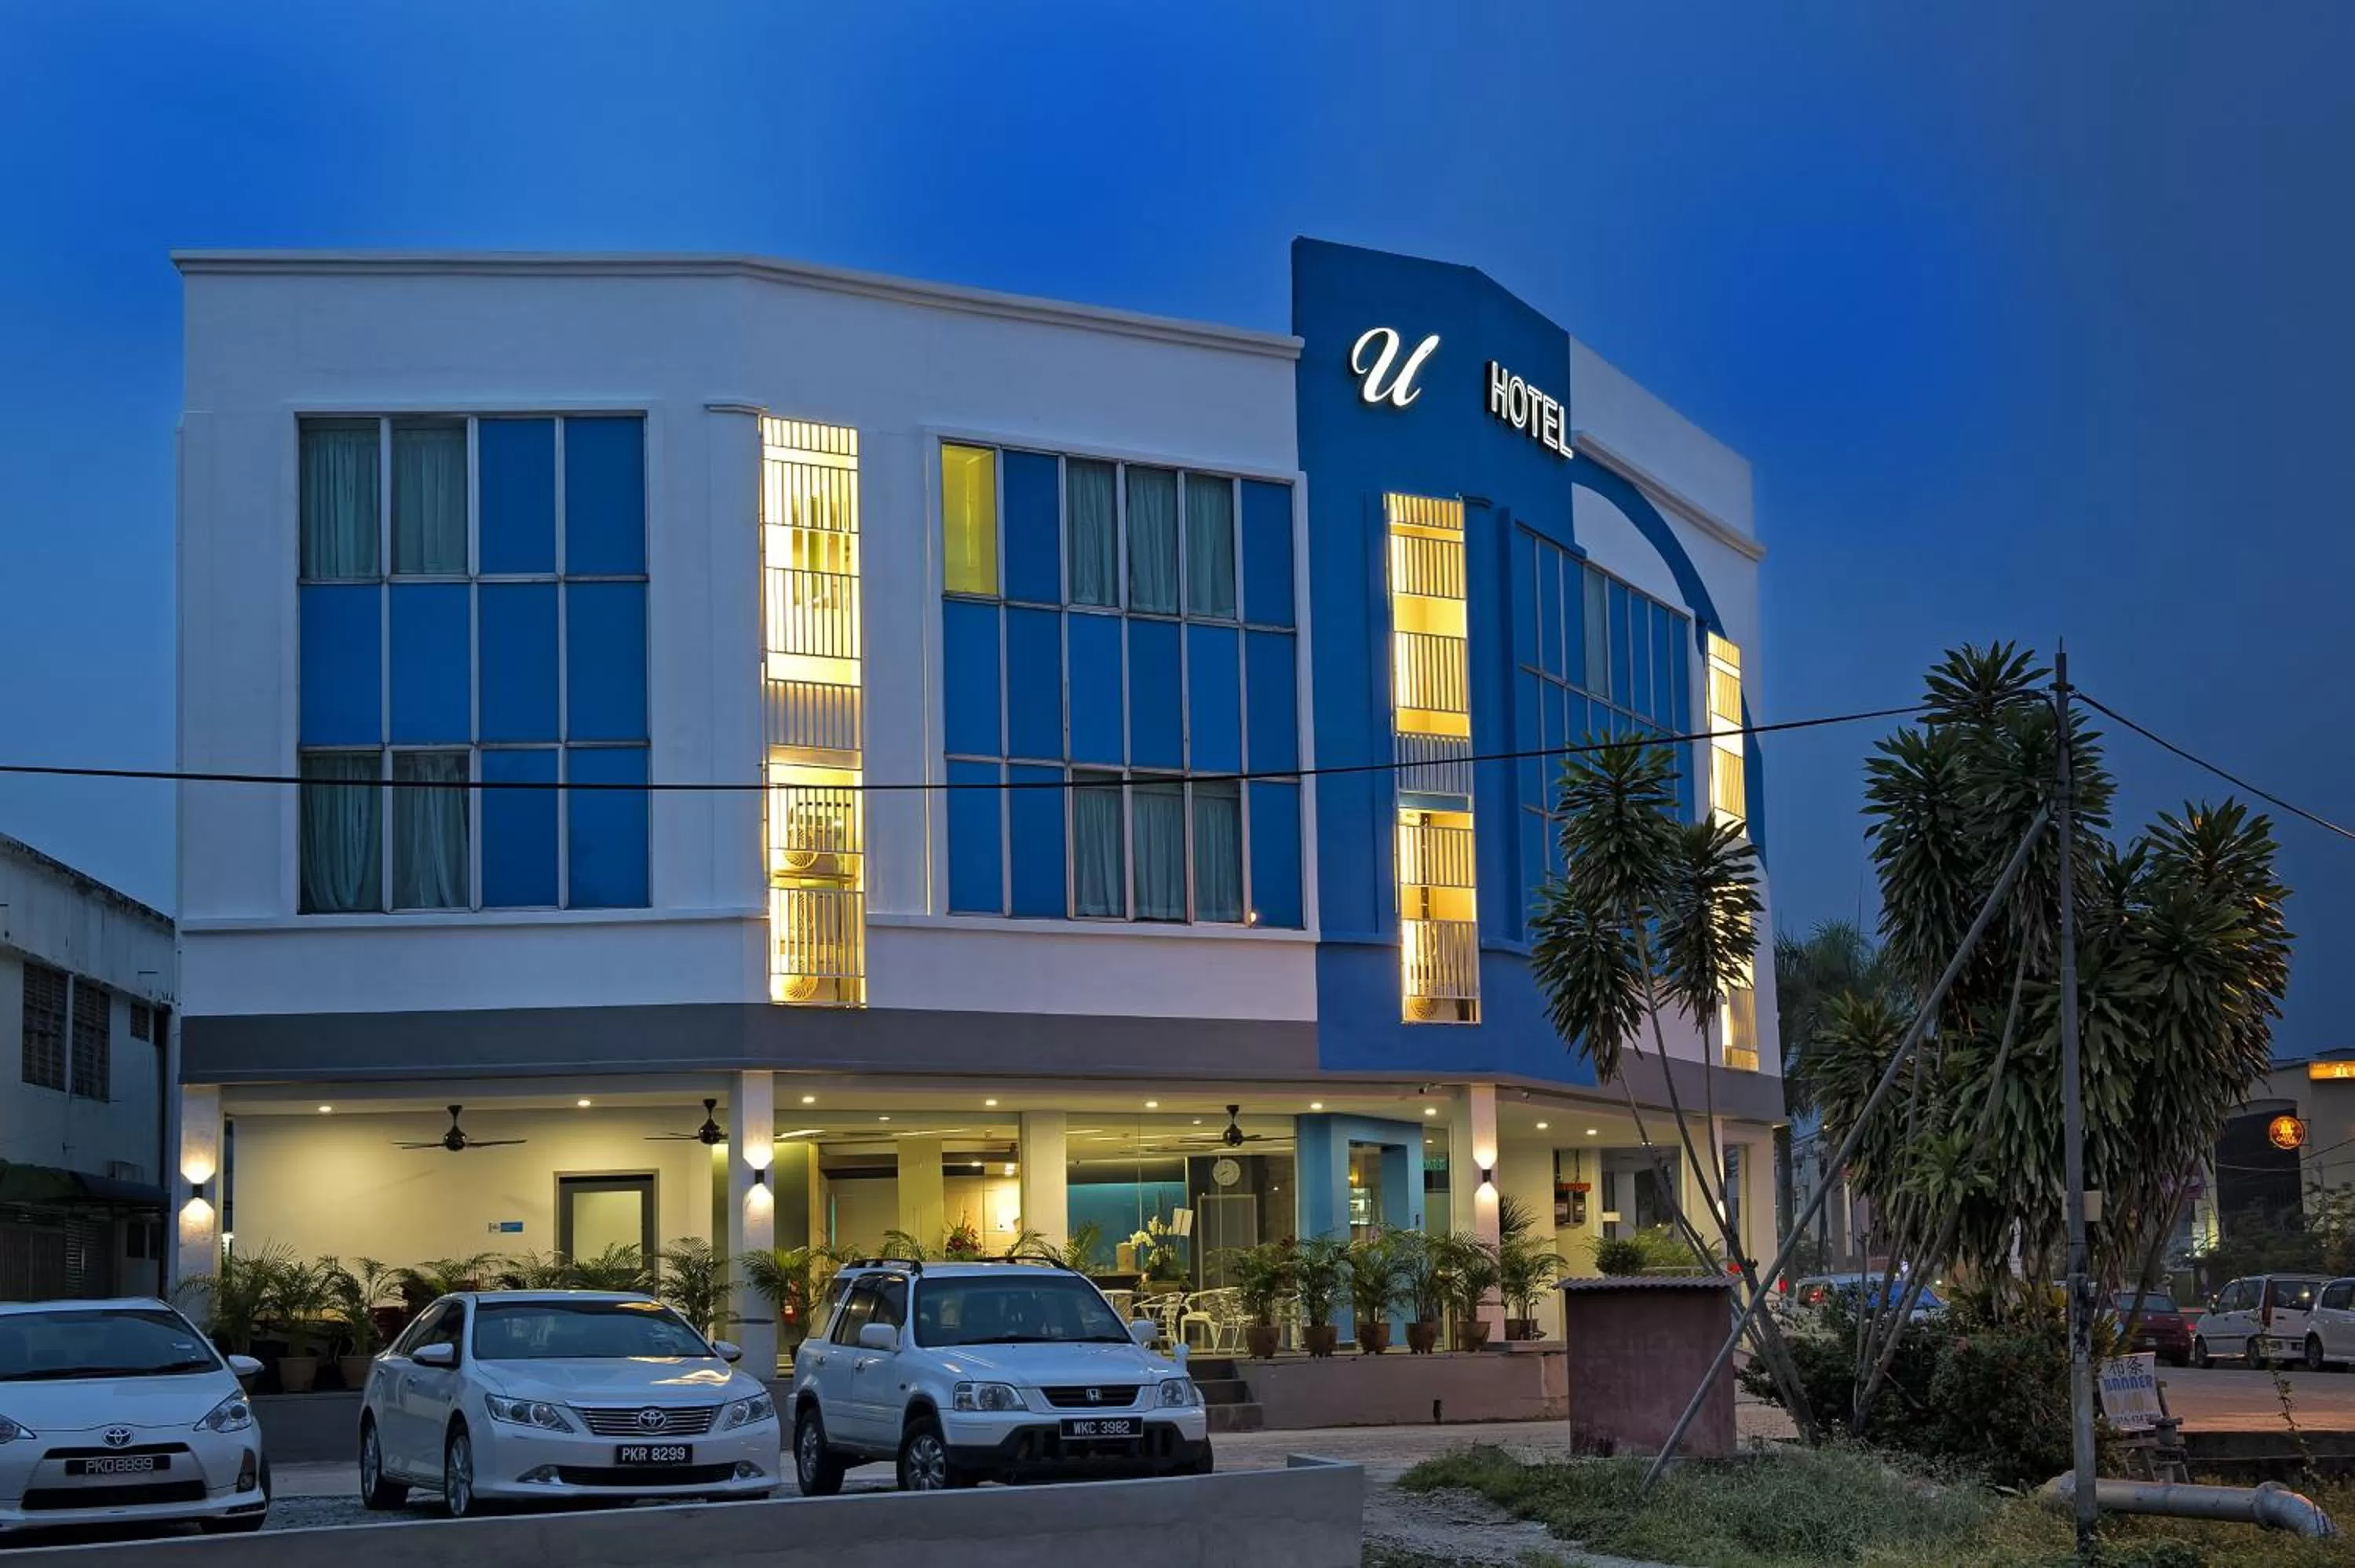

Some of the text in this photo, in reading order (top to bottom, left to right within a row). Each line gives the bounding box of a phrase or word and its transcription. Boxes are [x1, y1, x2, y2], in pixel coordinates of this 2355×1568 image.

[1351, 326, 1574, 459] U HOTEL
[1073, 1420, 1130, 1435] WKC 3982
[622, 1446, 686, 1461] PKR 8299
